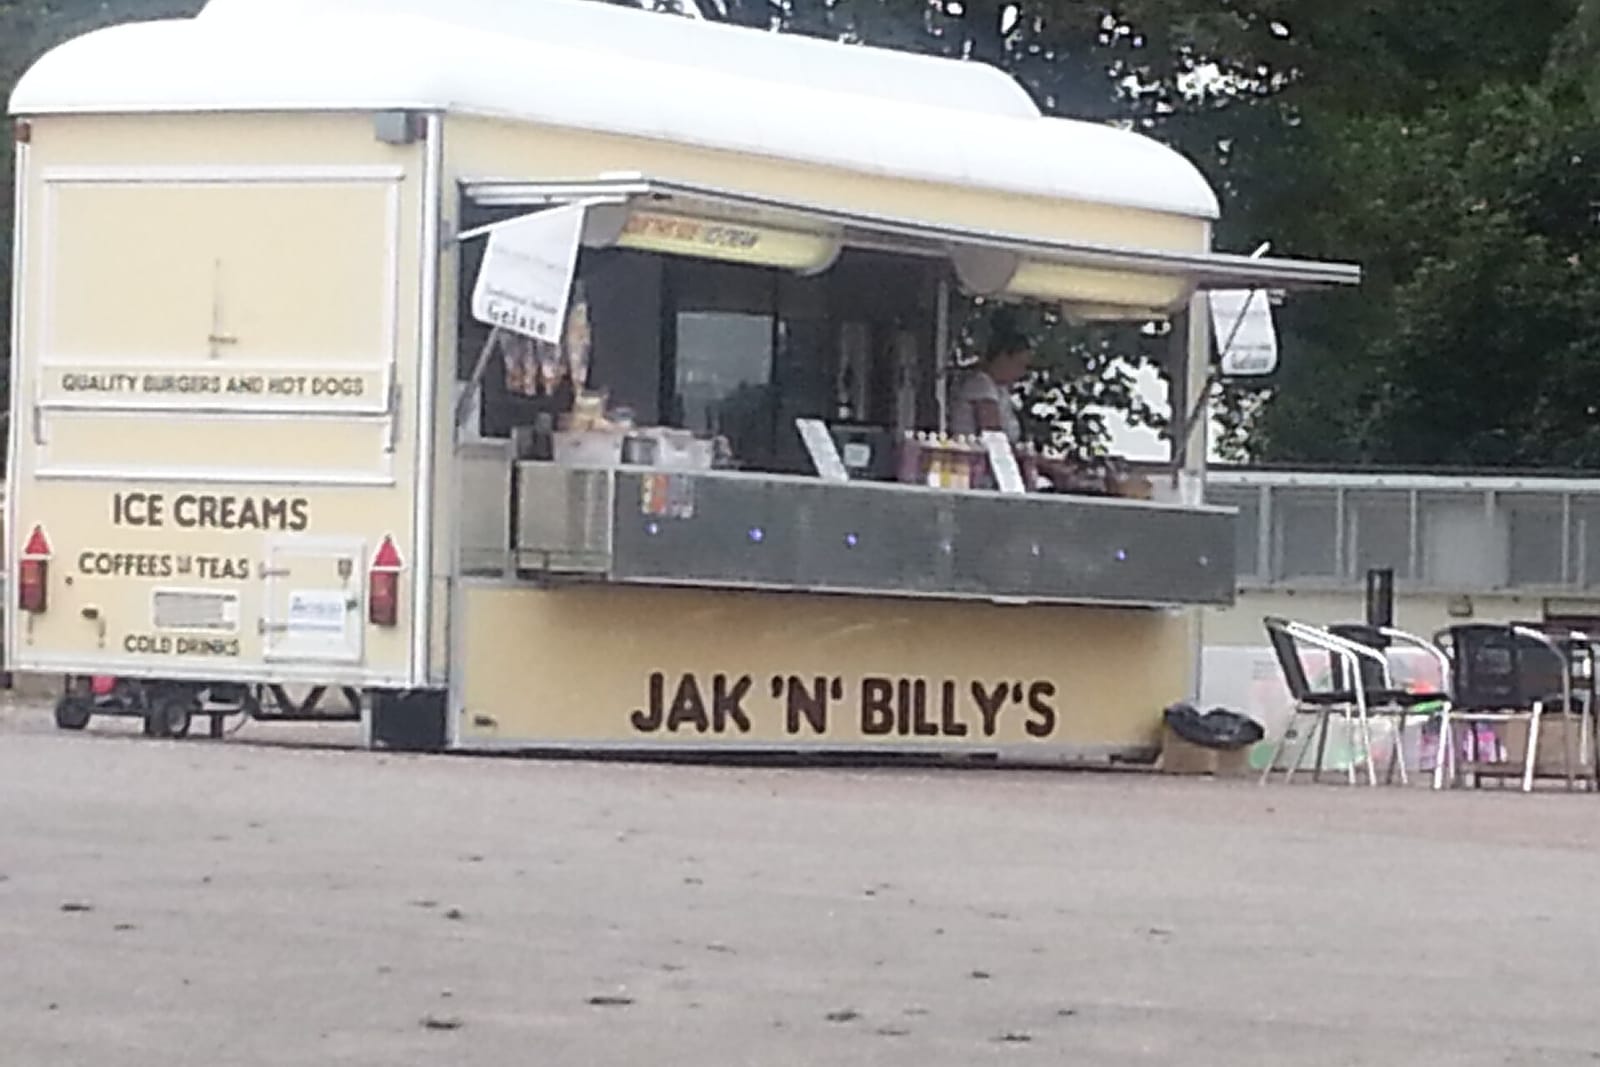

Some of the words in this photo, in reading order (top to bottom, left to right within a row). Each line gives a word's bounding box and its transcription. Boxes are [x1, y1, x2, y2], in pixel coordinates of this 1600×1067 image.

[62, 374, 137, 393] QUALITY
[143, 374, 221, 394] BURGERS
[226, 376, 263, 394] AND
[268, 377, 305, 395] HOT
[312, 377, 364, 395] DOGS
[113, 494, 163, 526] ICE
[174, 495, 308, 531] CREAMS
[79, 552, 172, 577] COFFEES
[196, 556, 249, 579] TEAS
[124, 635, 172, 654] COLD
[177, 638, 240, 656] DRINKS
[630, 672, 752, 733] JAK
[772, 675, 842, 735] 'N'
[861, 678, 1056, 737] BILLY'S
